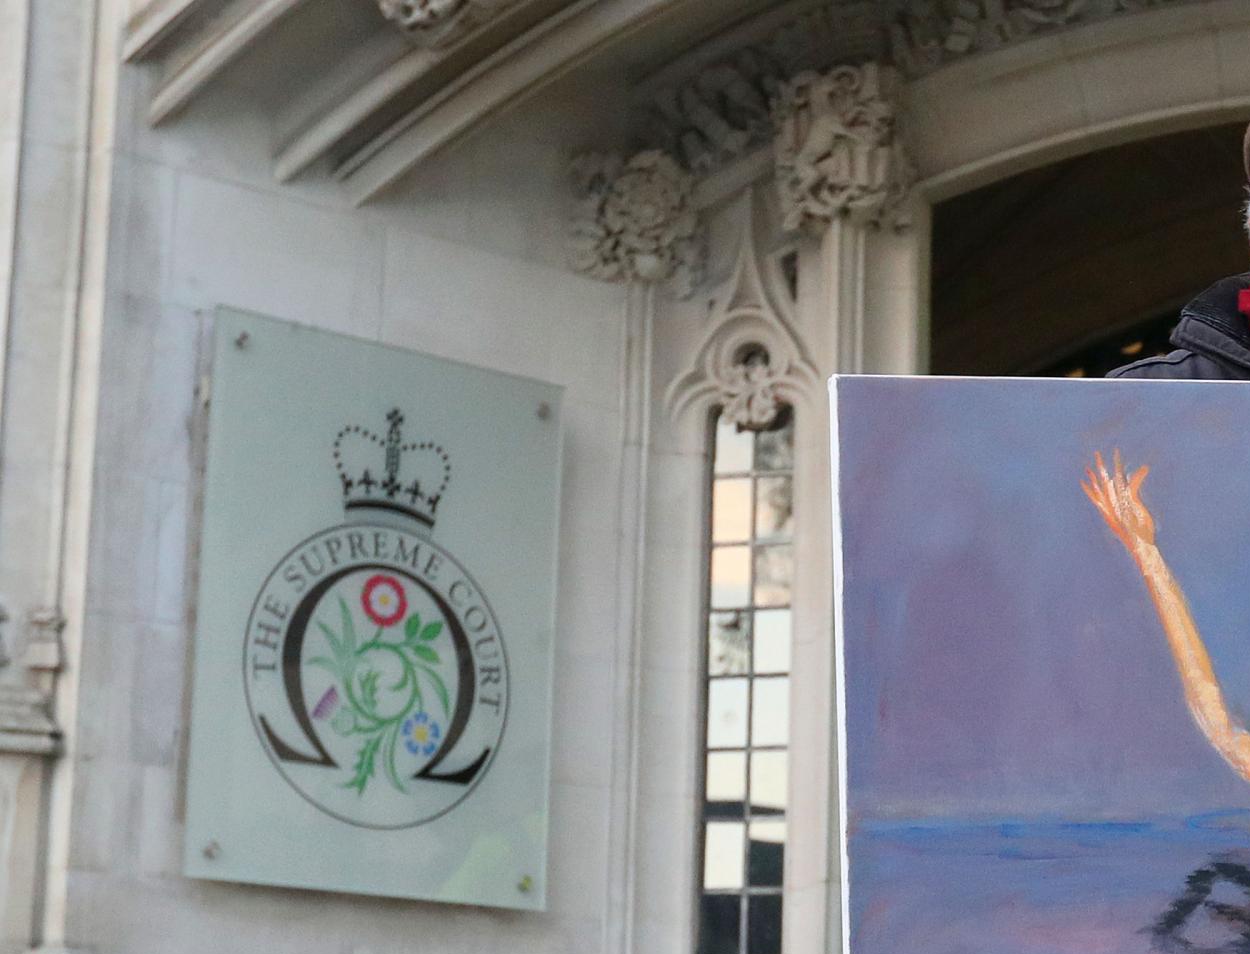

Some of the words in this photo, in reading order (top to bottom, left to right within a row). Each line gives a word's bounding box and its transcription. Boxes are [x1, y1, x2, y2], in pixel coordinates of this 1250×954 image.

[253, 594, 289, 679] THE
[283, 531, 446, 594] SUPREME
[448, 579, 500, 717] COURT
